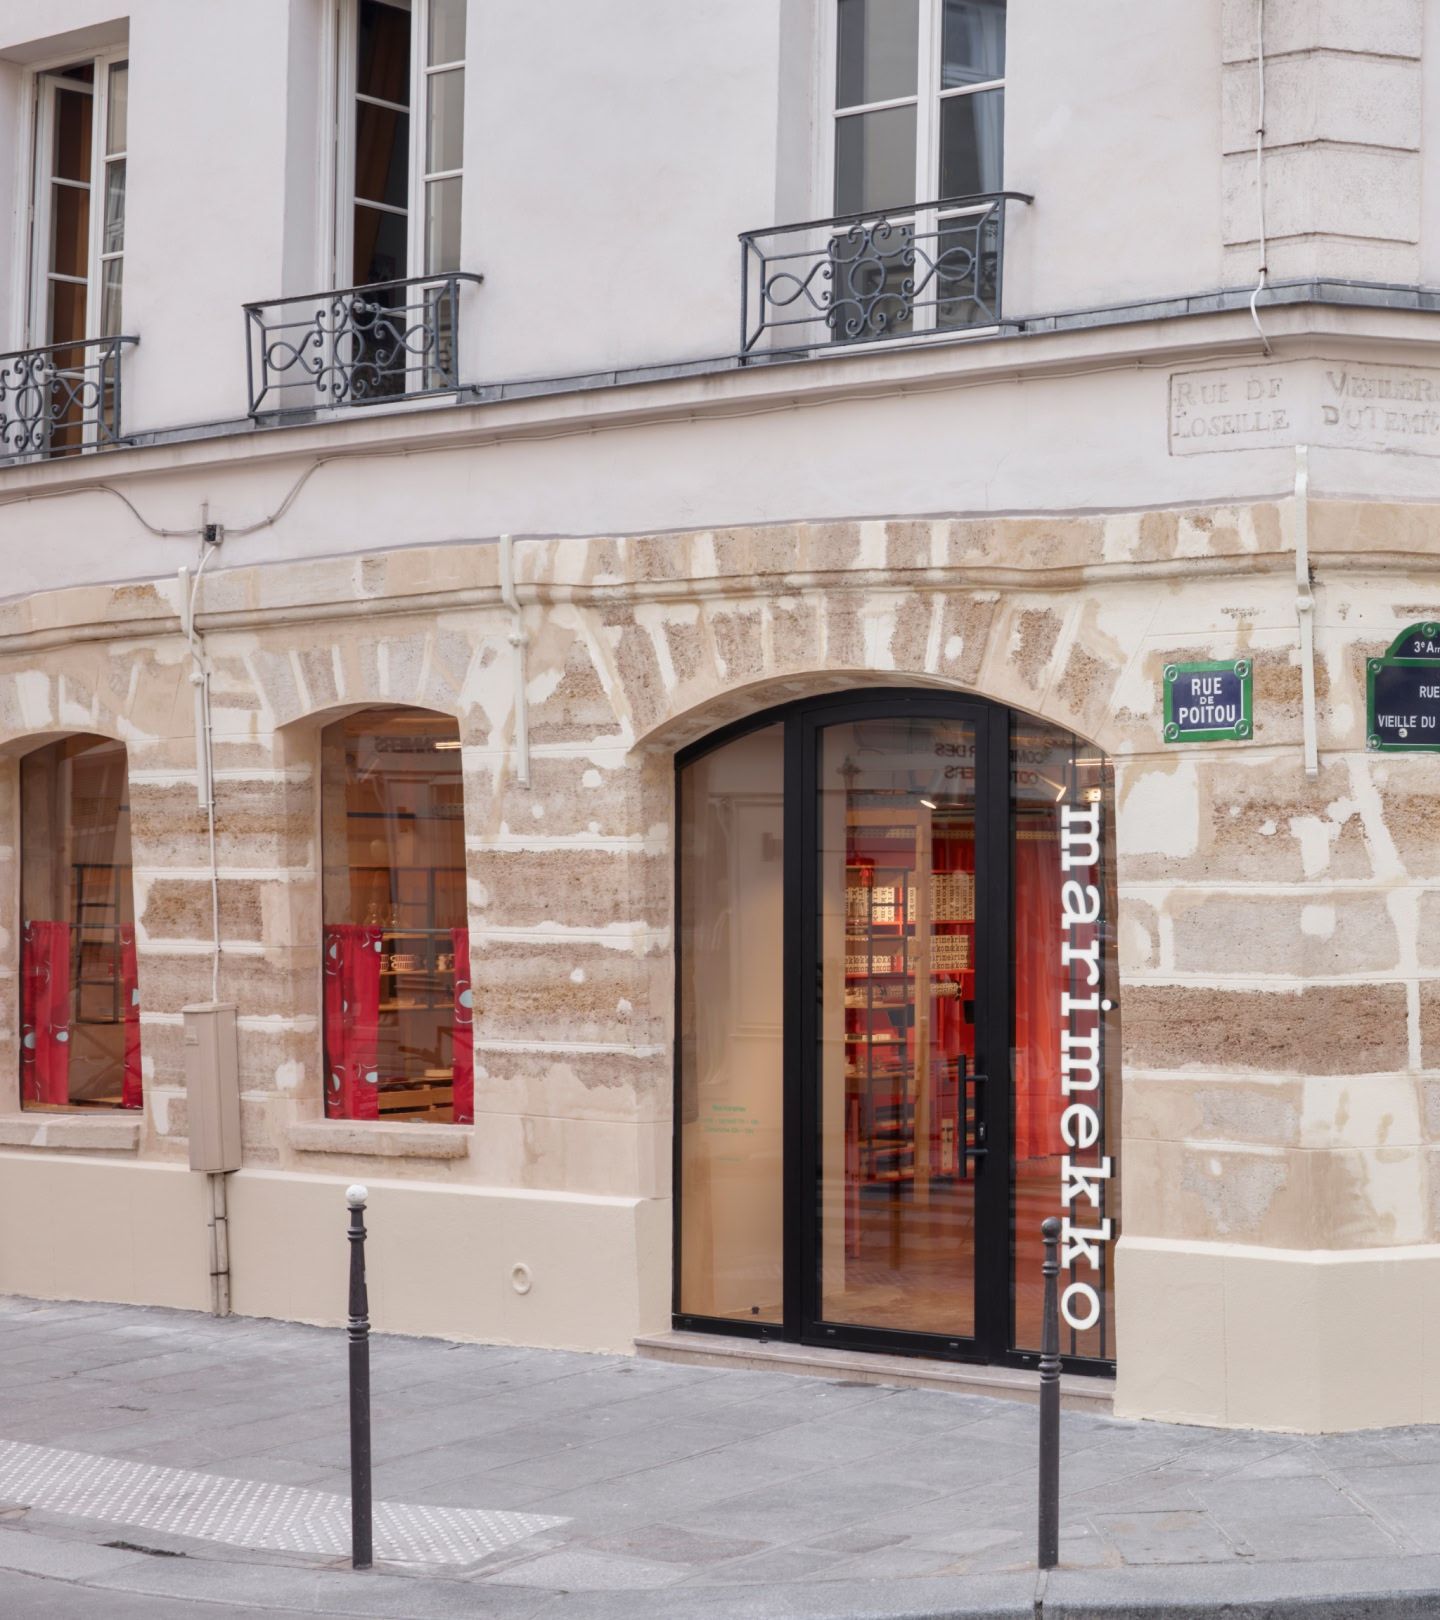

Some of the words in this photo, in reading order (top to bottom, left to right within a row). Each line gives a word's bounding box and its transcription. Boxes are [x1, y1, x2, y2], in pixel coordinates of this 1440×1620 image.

[1191, 677, 1222, 696] RUE
[1419, 685, 1440, 698] RUE
[1199, 695, 1215, 705] DE
[1179, 704, 1236, 725] POITOU
[1378, 715, 1417, 728] VIEILLE
[1421, 716, 1436, 729] DU
[1061, 803, 1113, 1330] marimekko
